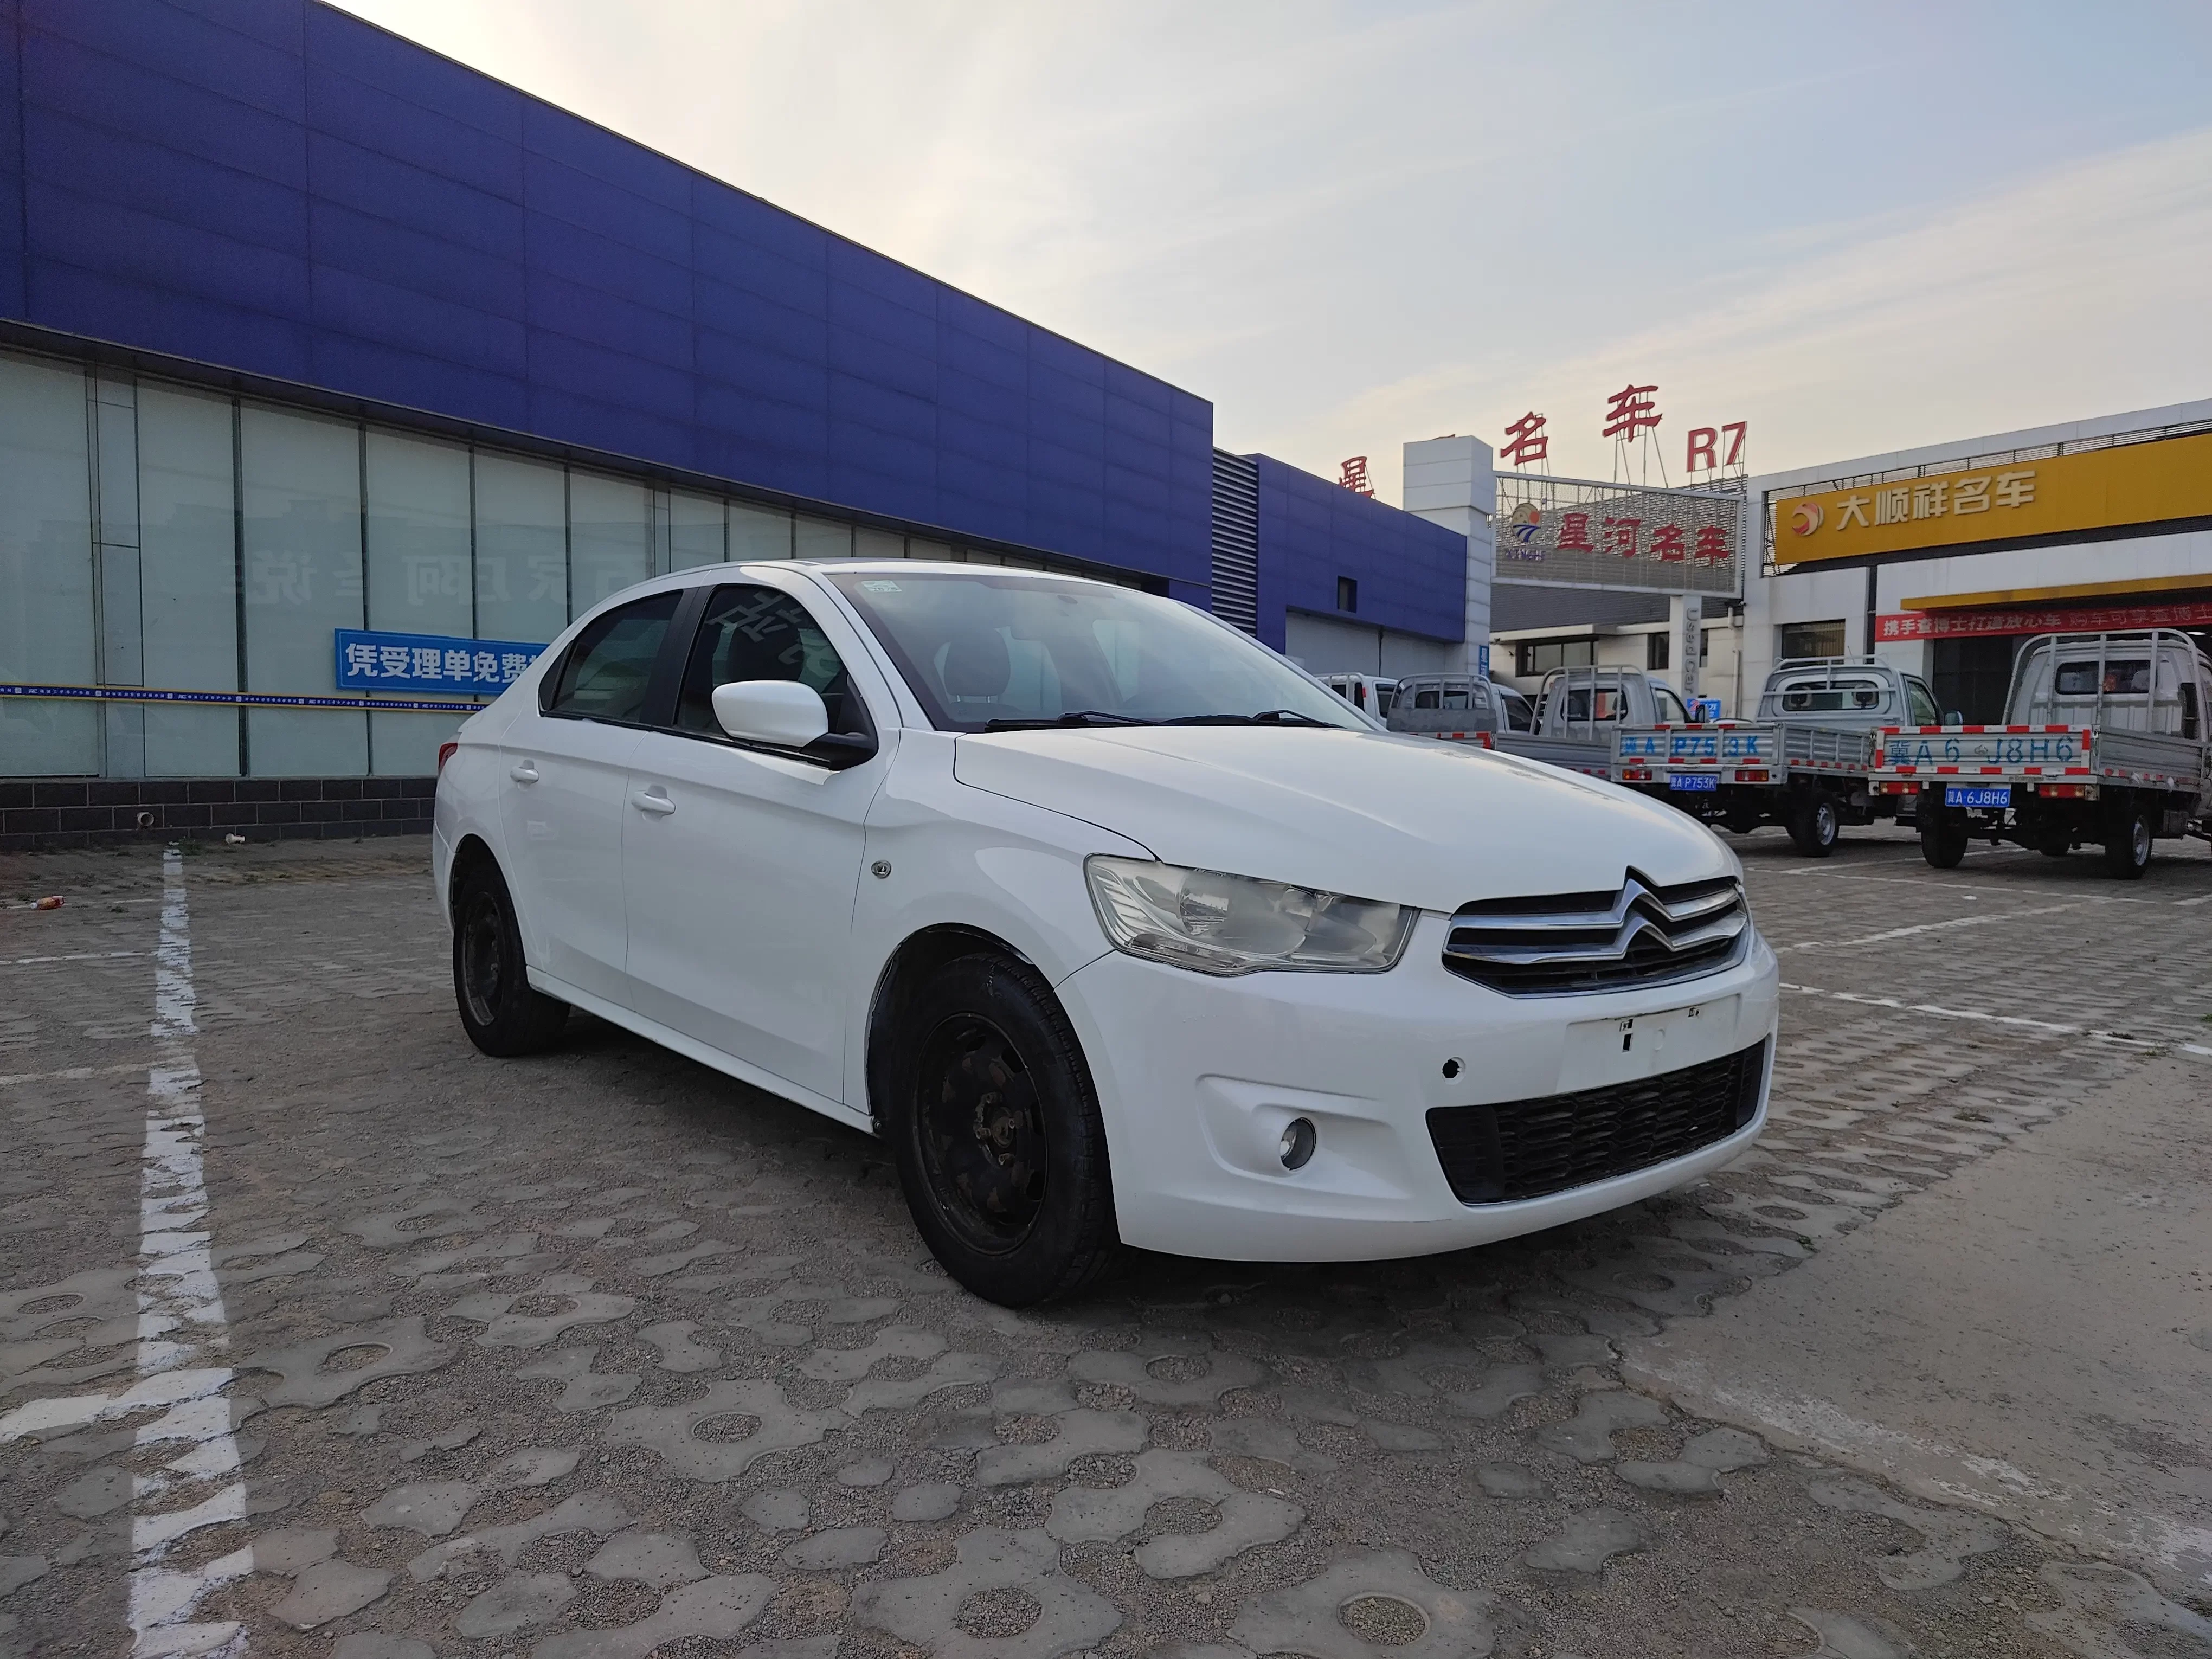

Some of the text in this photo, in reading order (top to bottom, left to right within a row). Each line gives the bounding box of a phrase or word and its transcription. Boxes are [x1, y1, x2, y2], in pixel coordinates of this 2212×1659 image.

[1687, 421, 1747, 472] R7
[1836, 470, 2036, 531] 大顺祥名车
[1557, 512, 1730, 565] 星河名车
[345, 642, 539, 684] 凭受理单免费
